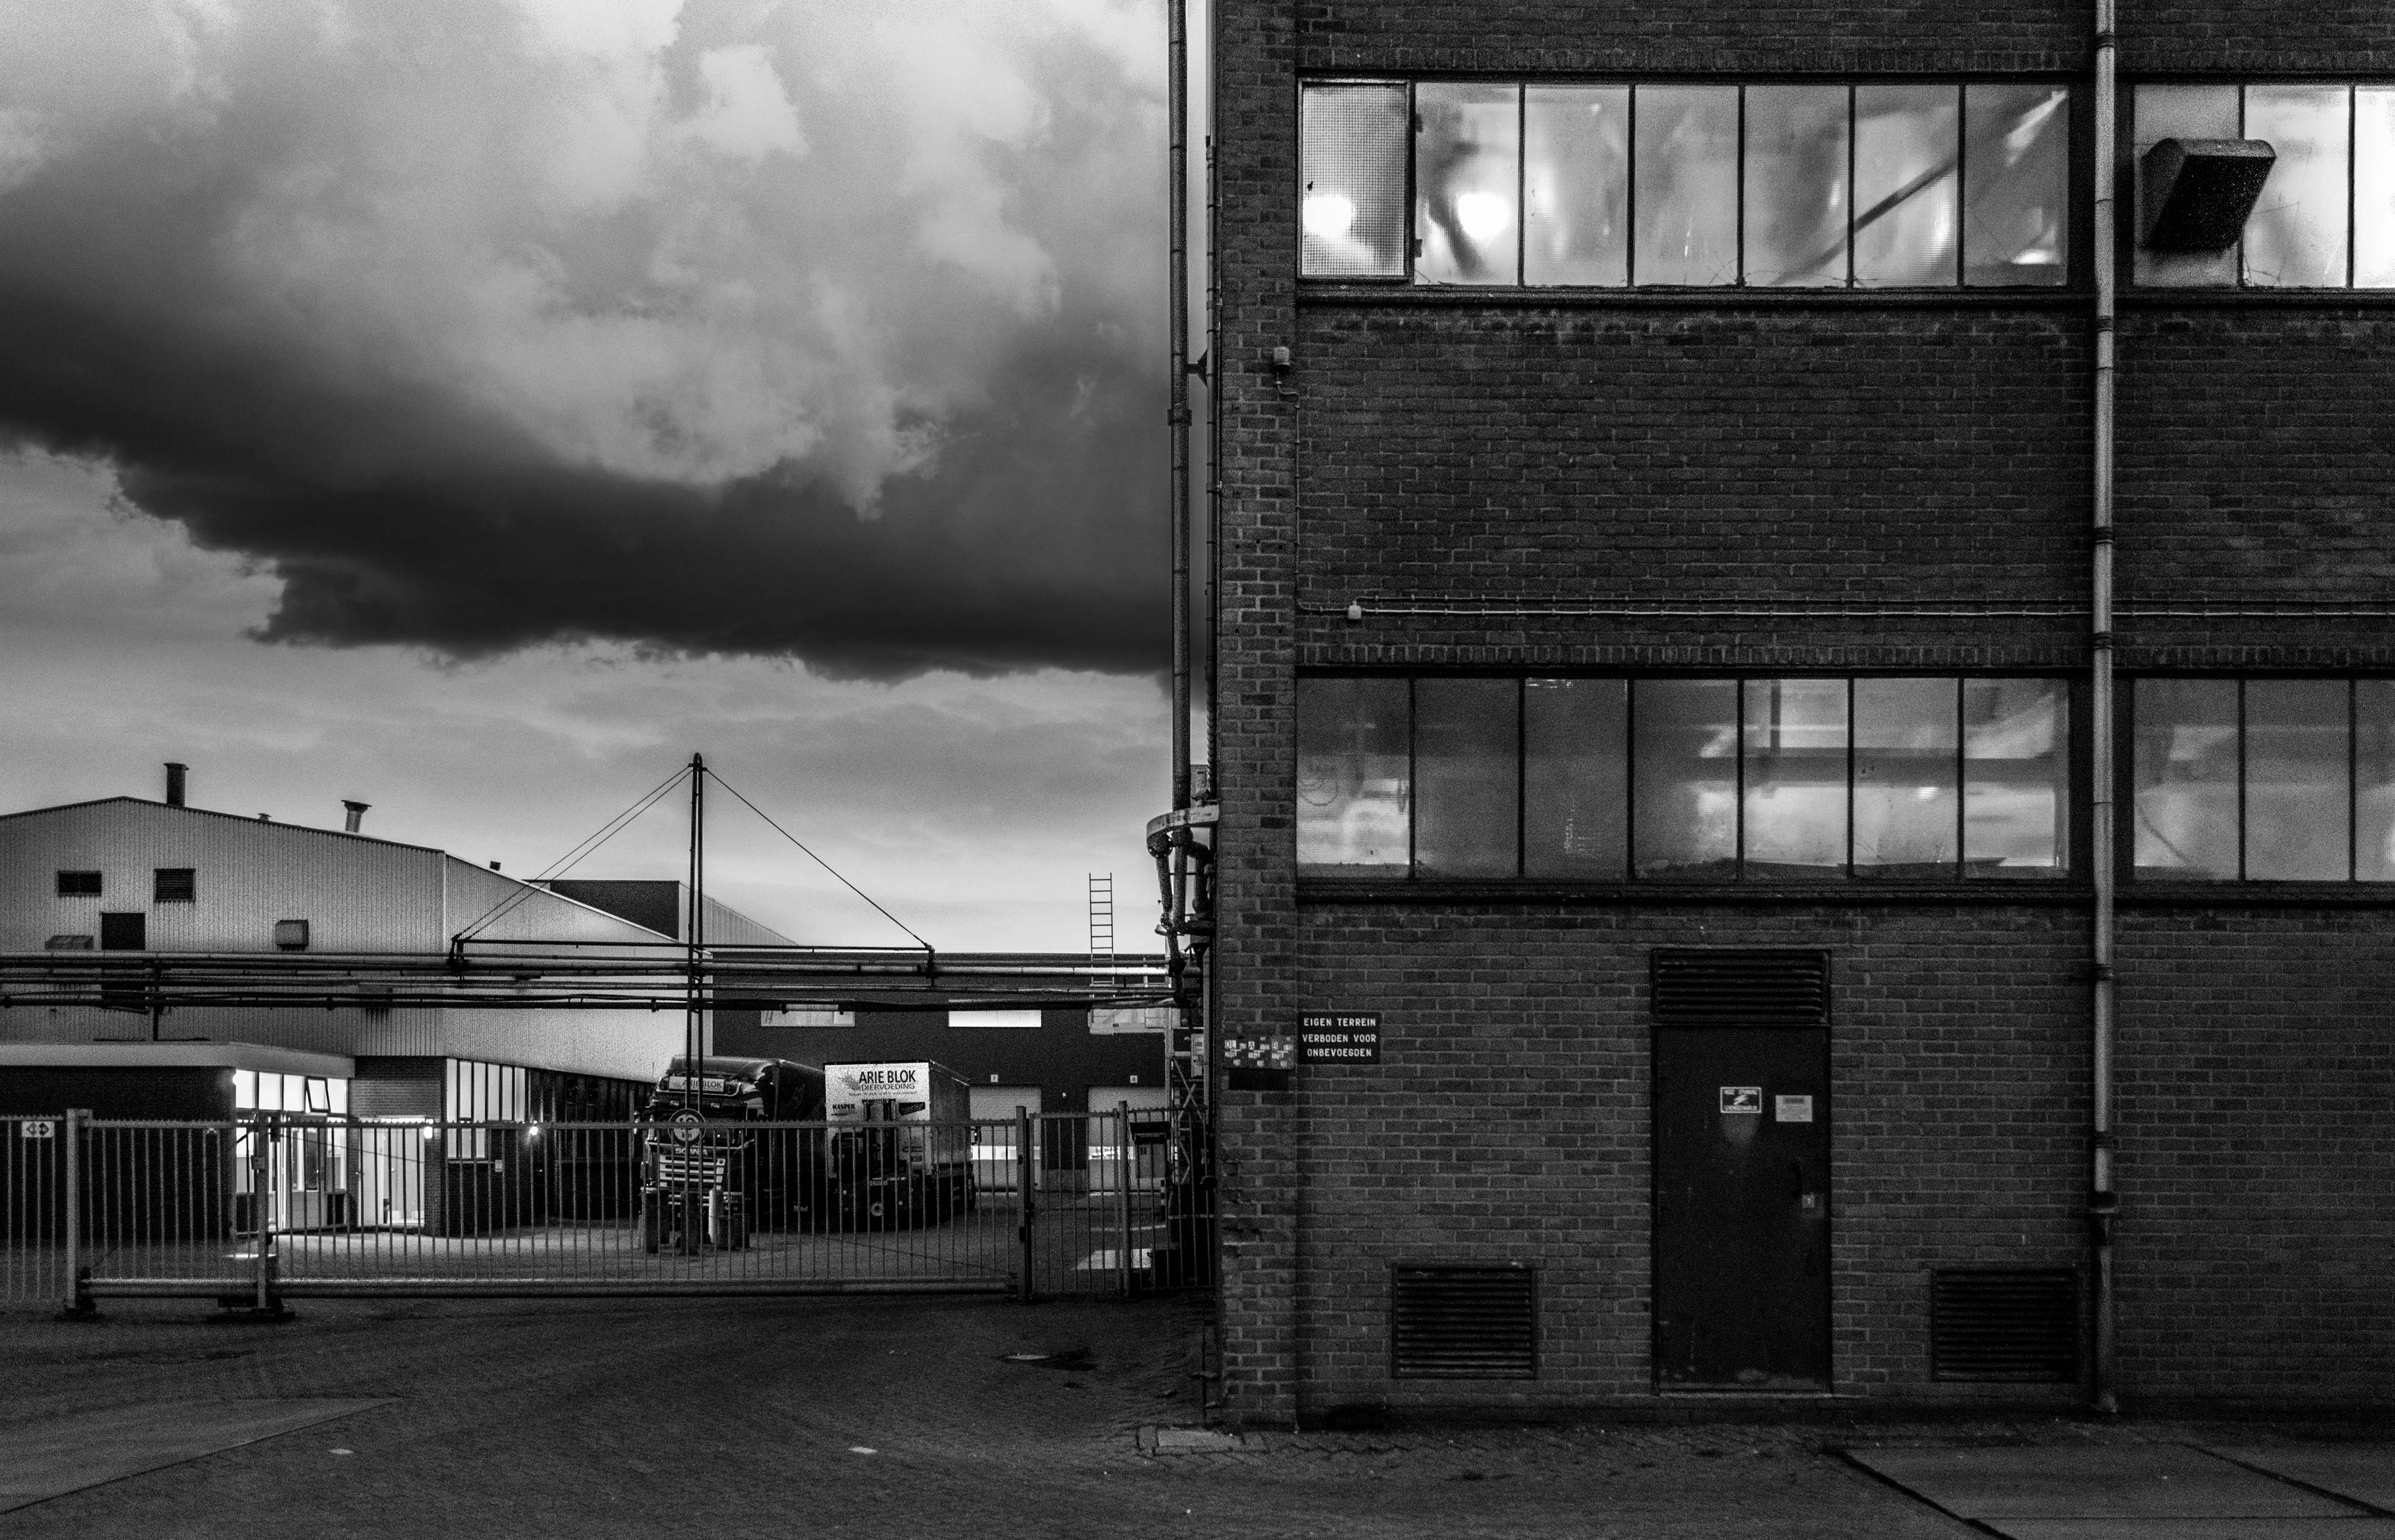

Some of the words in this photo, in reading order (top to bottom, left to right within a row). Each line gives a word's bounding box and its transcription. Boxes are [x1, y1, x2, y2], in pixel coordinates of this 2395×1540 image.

[1354, 1034, 1376, 1042] VOOR
[1308, 1048, 1371, 1057] ONBEVOEGDEN
[859, 1071, 884, 1084] ARIE
[887, 1070, 916, 1083] BLOK
